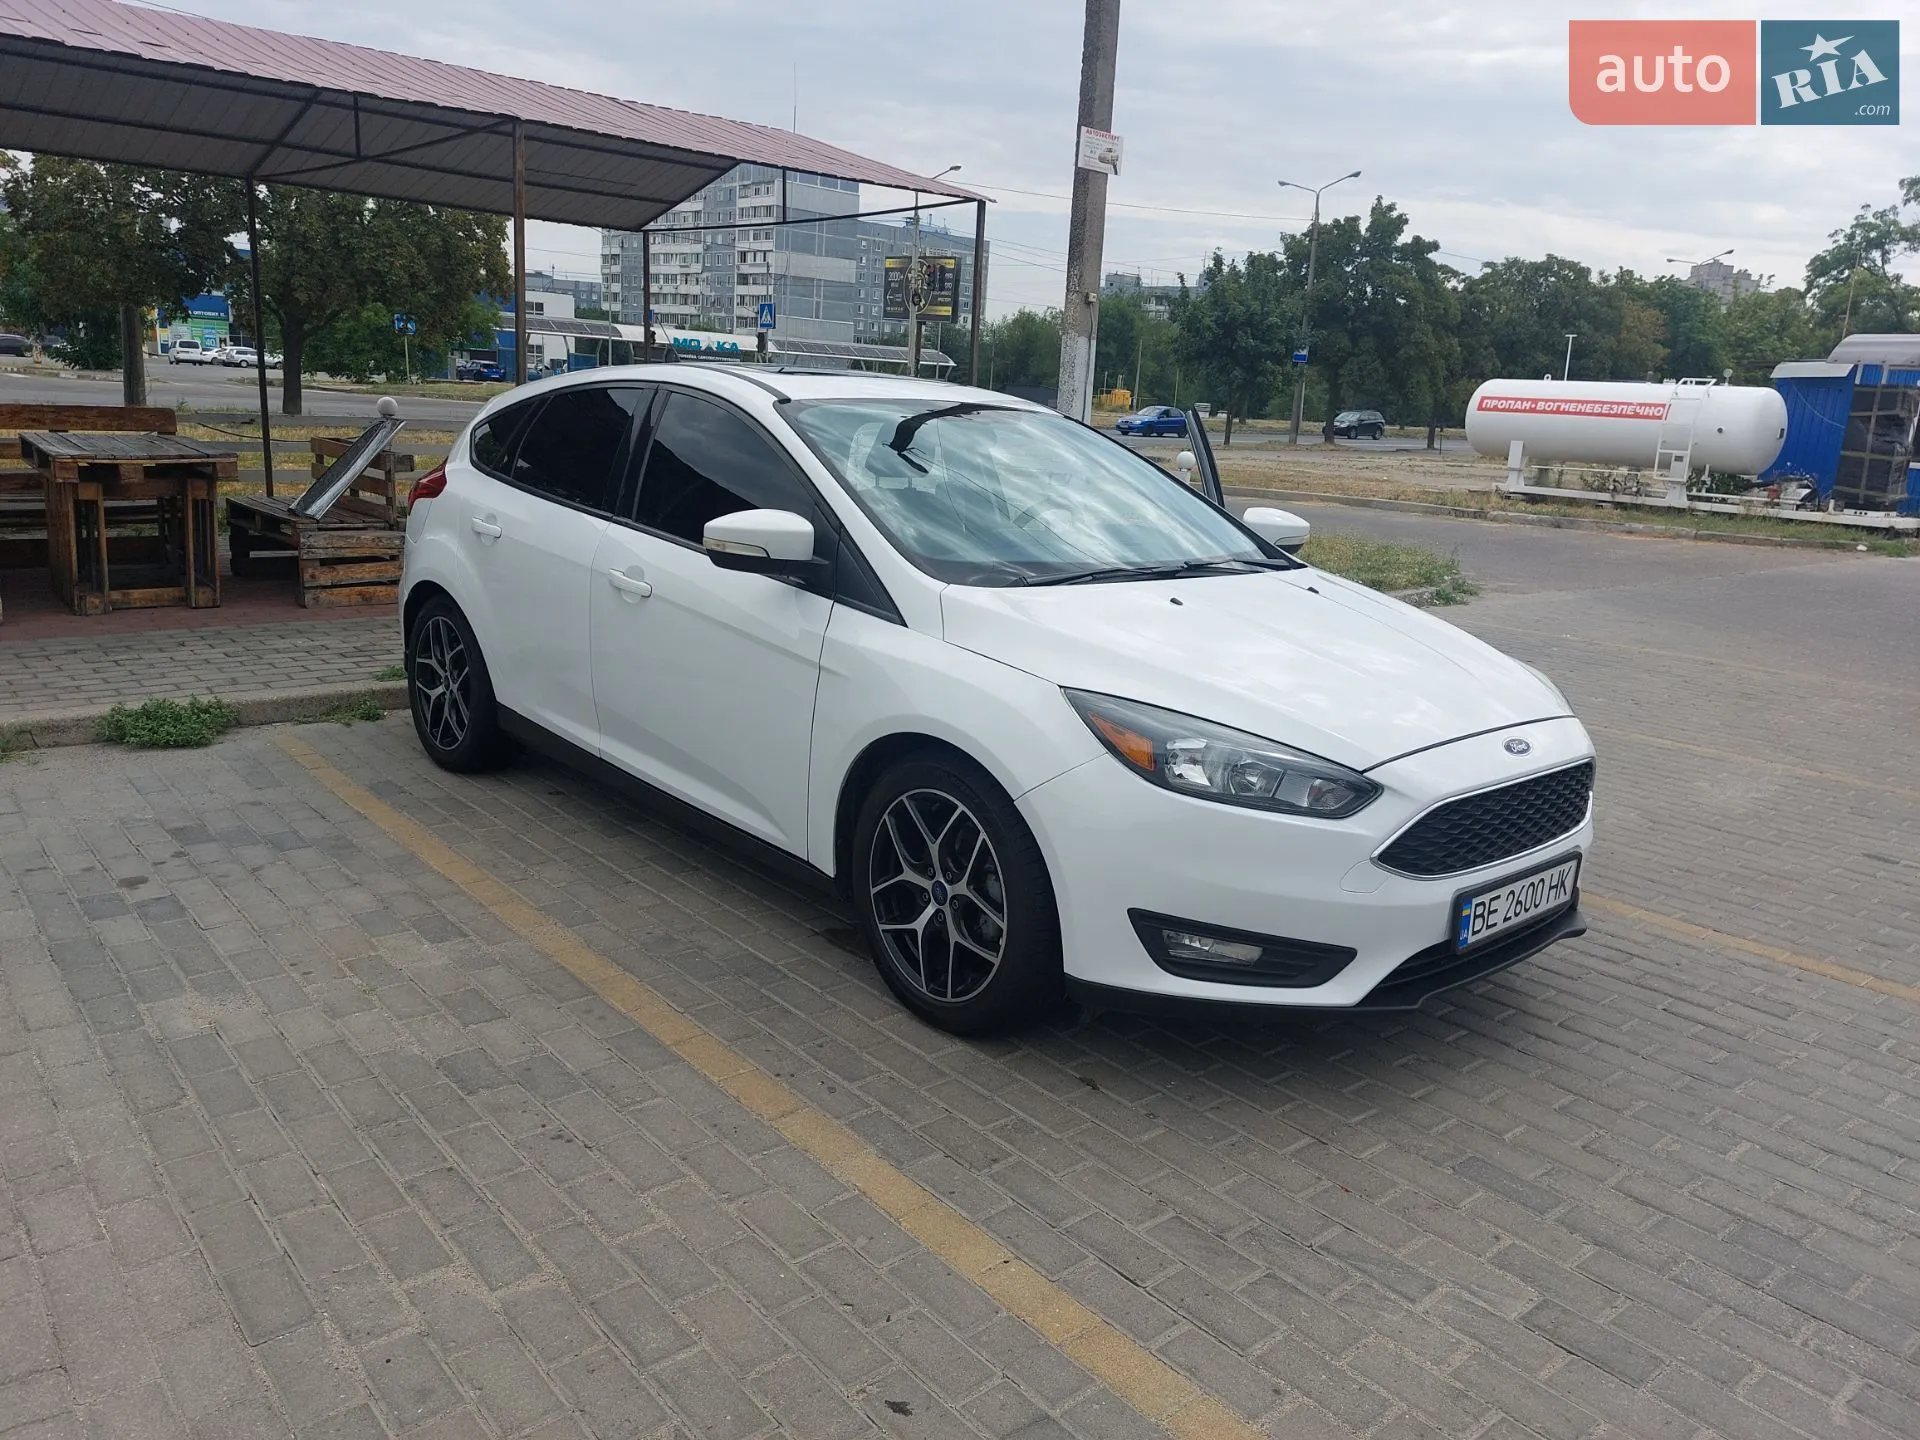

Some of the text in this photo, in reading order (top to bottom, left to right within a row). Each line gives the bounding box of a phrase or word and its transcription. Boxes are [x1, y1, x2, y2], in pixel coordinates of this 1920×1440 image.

[1471, 865, 1573, 937] BE 2600 HK
